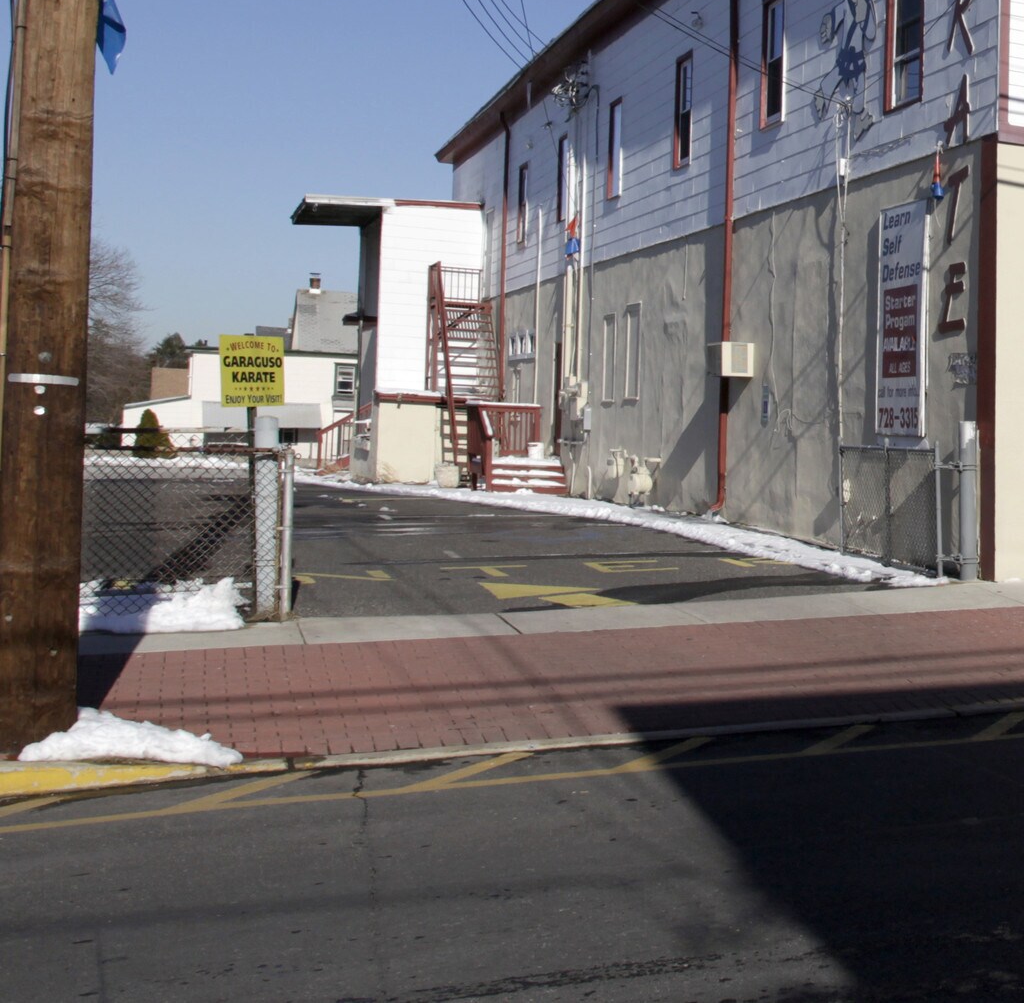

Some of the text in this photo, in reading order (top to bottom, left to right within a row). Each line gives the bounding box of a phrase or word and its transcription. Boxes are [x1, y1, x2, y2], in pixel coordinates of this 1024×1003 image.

[883, 211, 911, 230] Learn
[882, 234, 902, 256] Self
[882, 261, 920, 283] Defense
[885, 295, 916, 311] Starter
[229, 340, 276, 353] WELCOME TO
[223, 355, 283, 368] GARAGUSO
[232, 371, 276, 383] KARATE
[225, 394, 245, 404] ENJOY
[247, 394, 264, 404] YOUR
[879, 407, 919, 428] 728-3315
